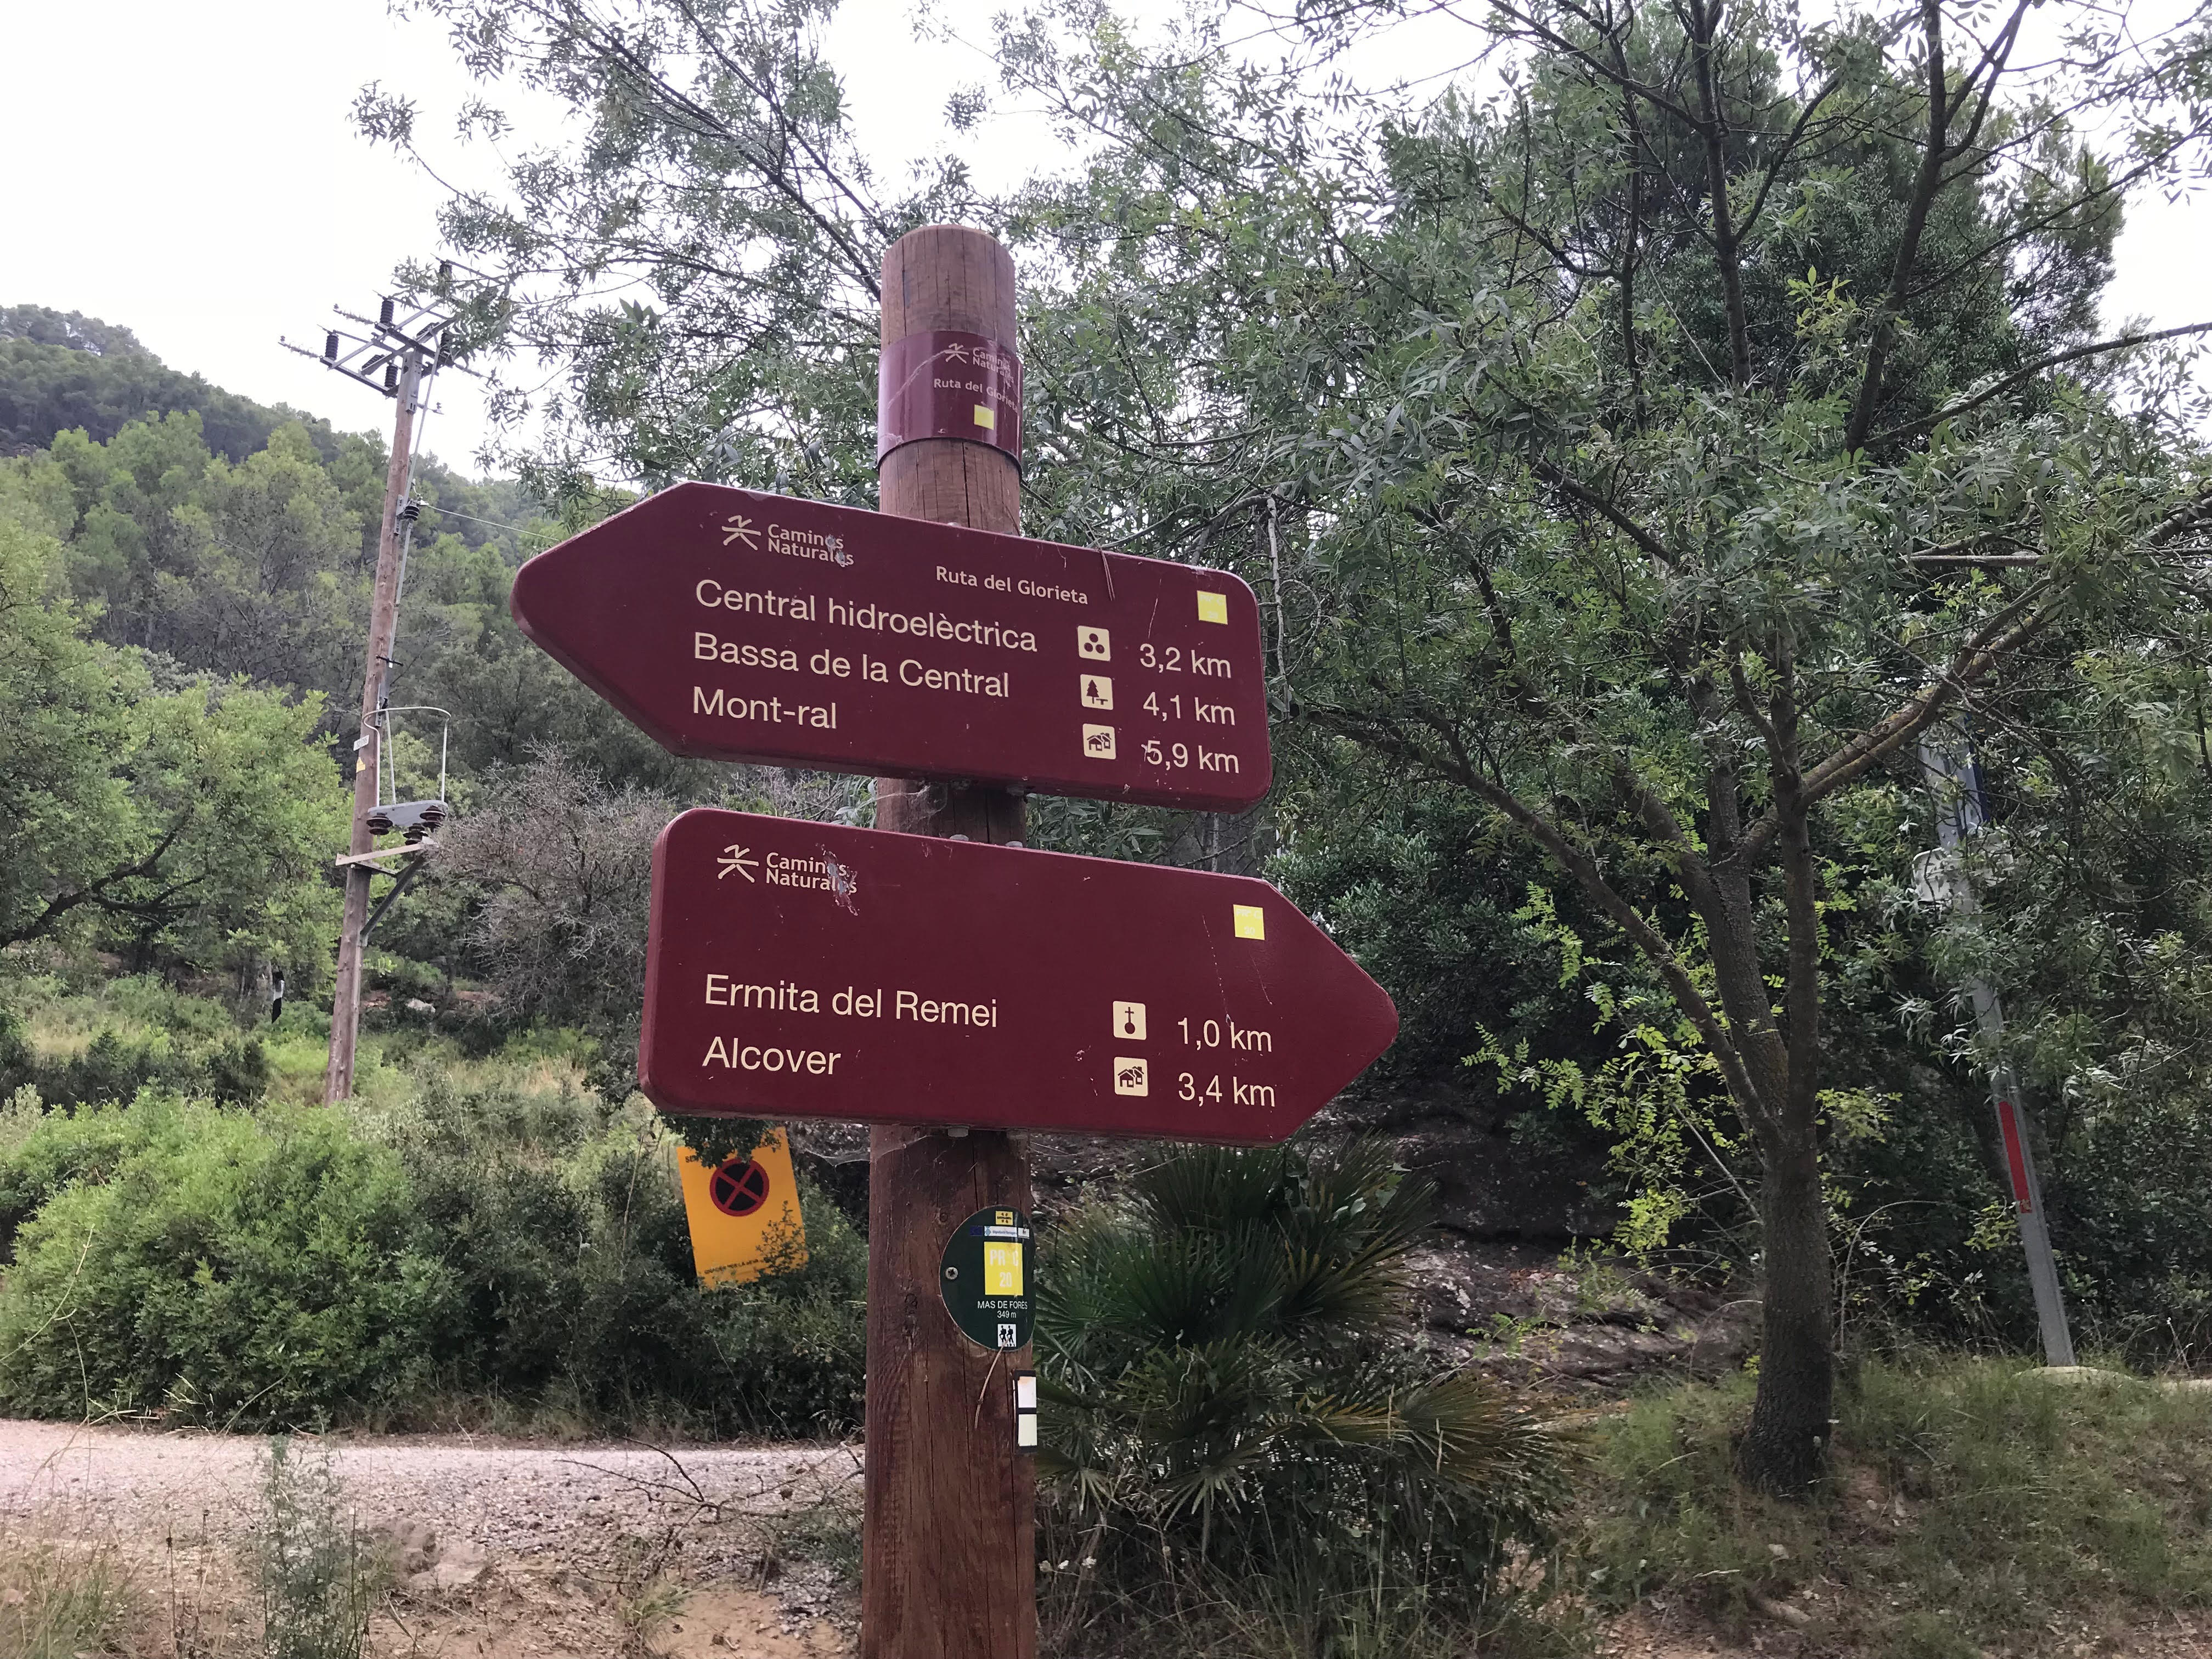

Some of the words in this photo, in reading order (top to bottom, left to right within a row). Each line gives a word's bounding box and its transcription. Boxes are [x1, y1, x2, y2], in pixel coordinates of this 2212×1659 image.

[934, 379, 961, 389] Ruta
[966, 381, 983, 393] del
[936, 566, 978, 587] Ruta
[984, 574, 1012, 592] del
[1018, 580, 1088, 605] Glorieta
[696, 579, 815, 621] Central
[829, 597, 1037, 652] hidroelèctrica
[695, 631, 799, 672] Bassa
[810, 649, 851, 678] de
[862, 653, 889, 683] la
[899, 659, 1009, 697] Central
[1140, 643, 1181, 673] 3,2
[1191, 650, 1231, 678] km
[693, 686, 836, 729] Mont-ral
[1143, 691, 1181, 721] 4,1
[1194, 697, 1235, 725] km
[1147, 740, 1188, 769] 5,9
[1198, 745, 1239, 774] km
[706, 974, 820, 1013] Ermita
[832, 986, 882, 1018] del
[896, 990, 996, 1028] Remei
[1177, 1017, 1220, 1051] 1,0
[1230, 1022, 1272, 1052] km
[702, 1036, 842, 1075] Alcover
[1178, 1072, 1223, 1107] 3,4
[1233, 1076, 1275, 1107] km
[1000, 1272, 1012, 1287] 20
[978, 1300, 996, 1309] MAS
[997, 1300, 1008, 1309] DE
[997, 1310, 1009, 1318] 349
